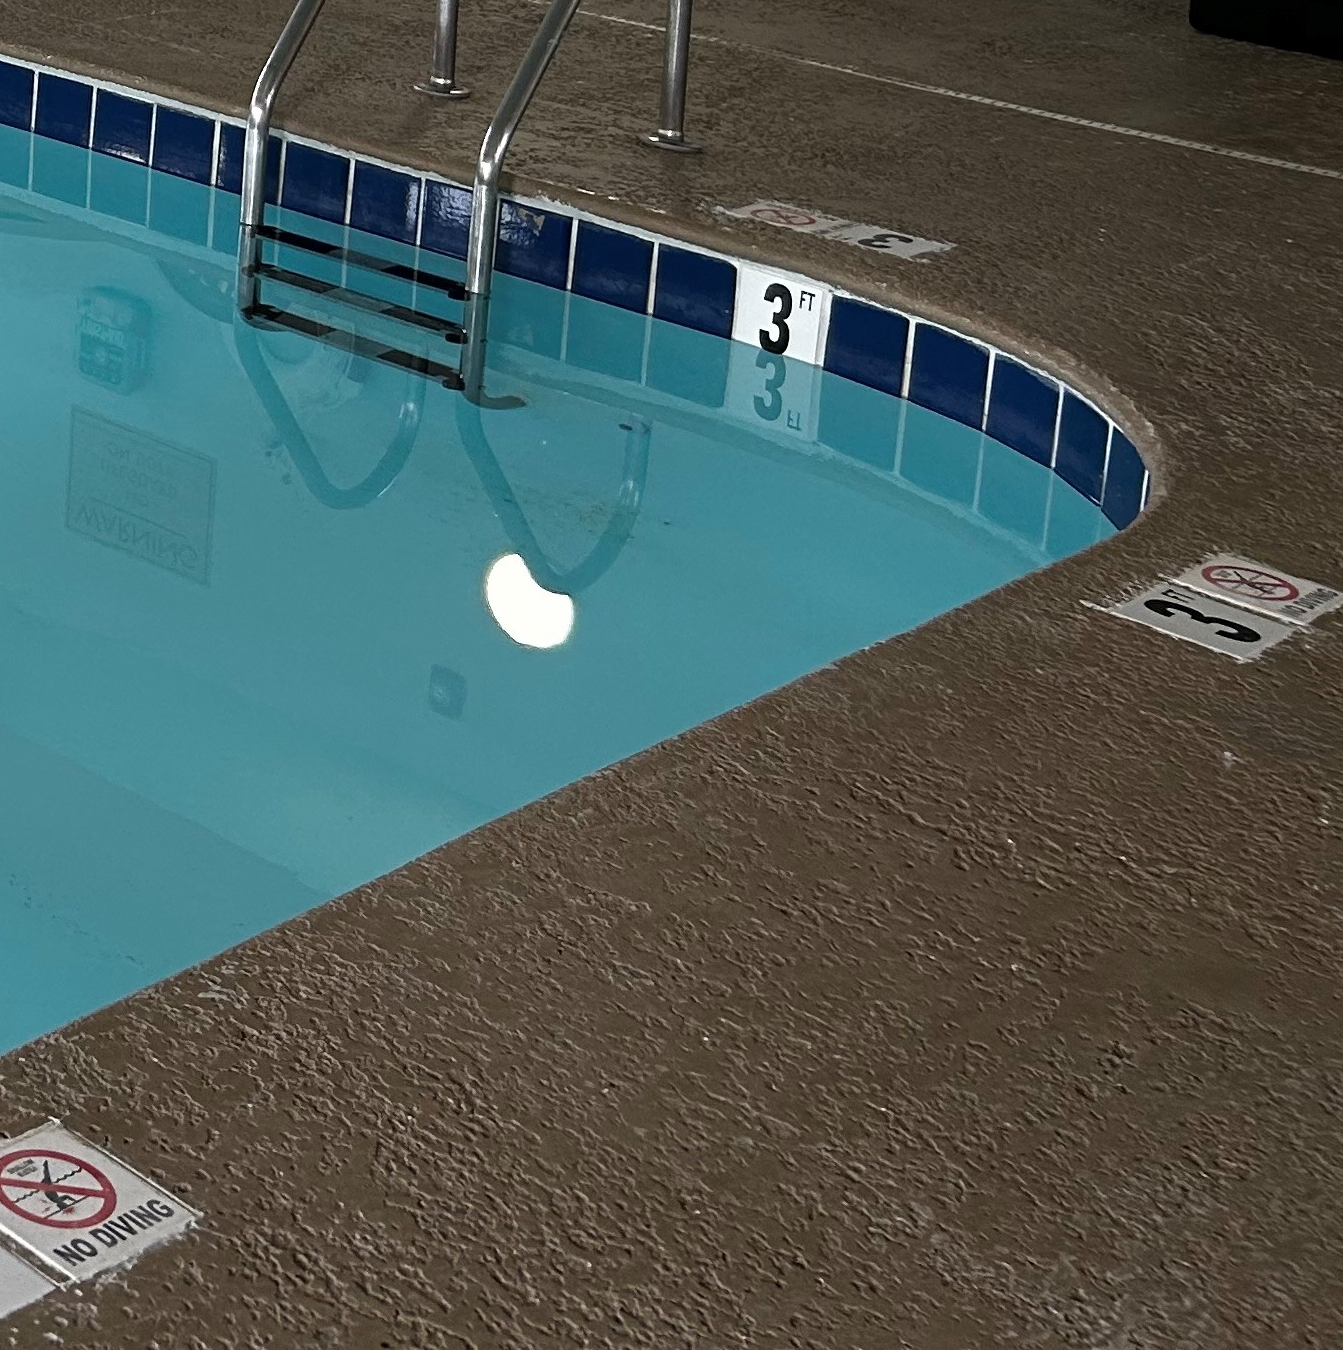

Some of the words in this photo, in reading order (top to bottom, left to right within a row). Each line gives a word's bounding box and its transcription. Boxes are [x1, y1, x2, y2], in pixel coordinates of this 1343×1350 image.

[759, 282, 793, 355] 3
[799, 290, 816, 312] FT
[1143, 599, 1262, 643] 3
[53, 1238, 99, 1267] NO
[99, 1198, 176, 1248] DIVING
